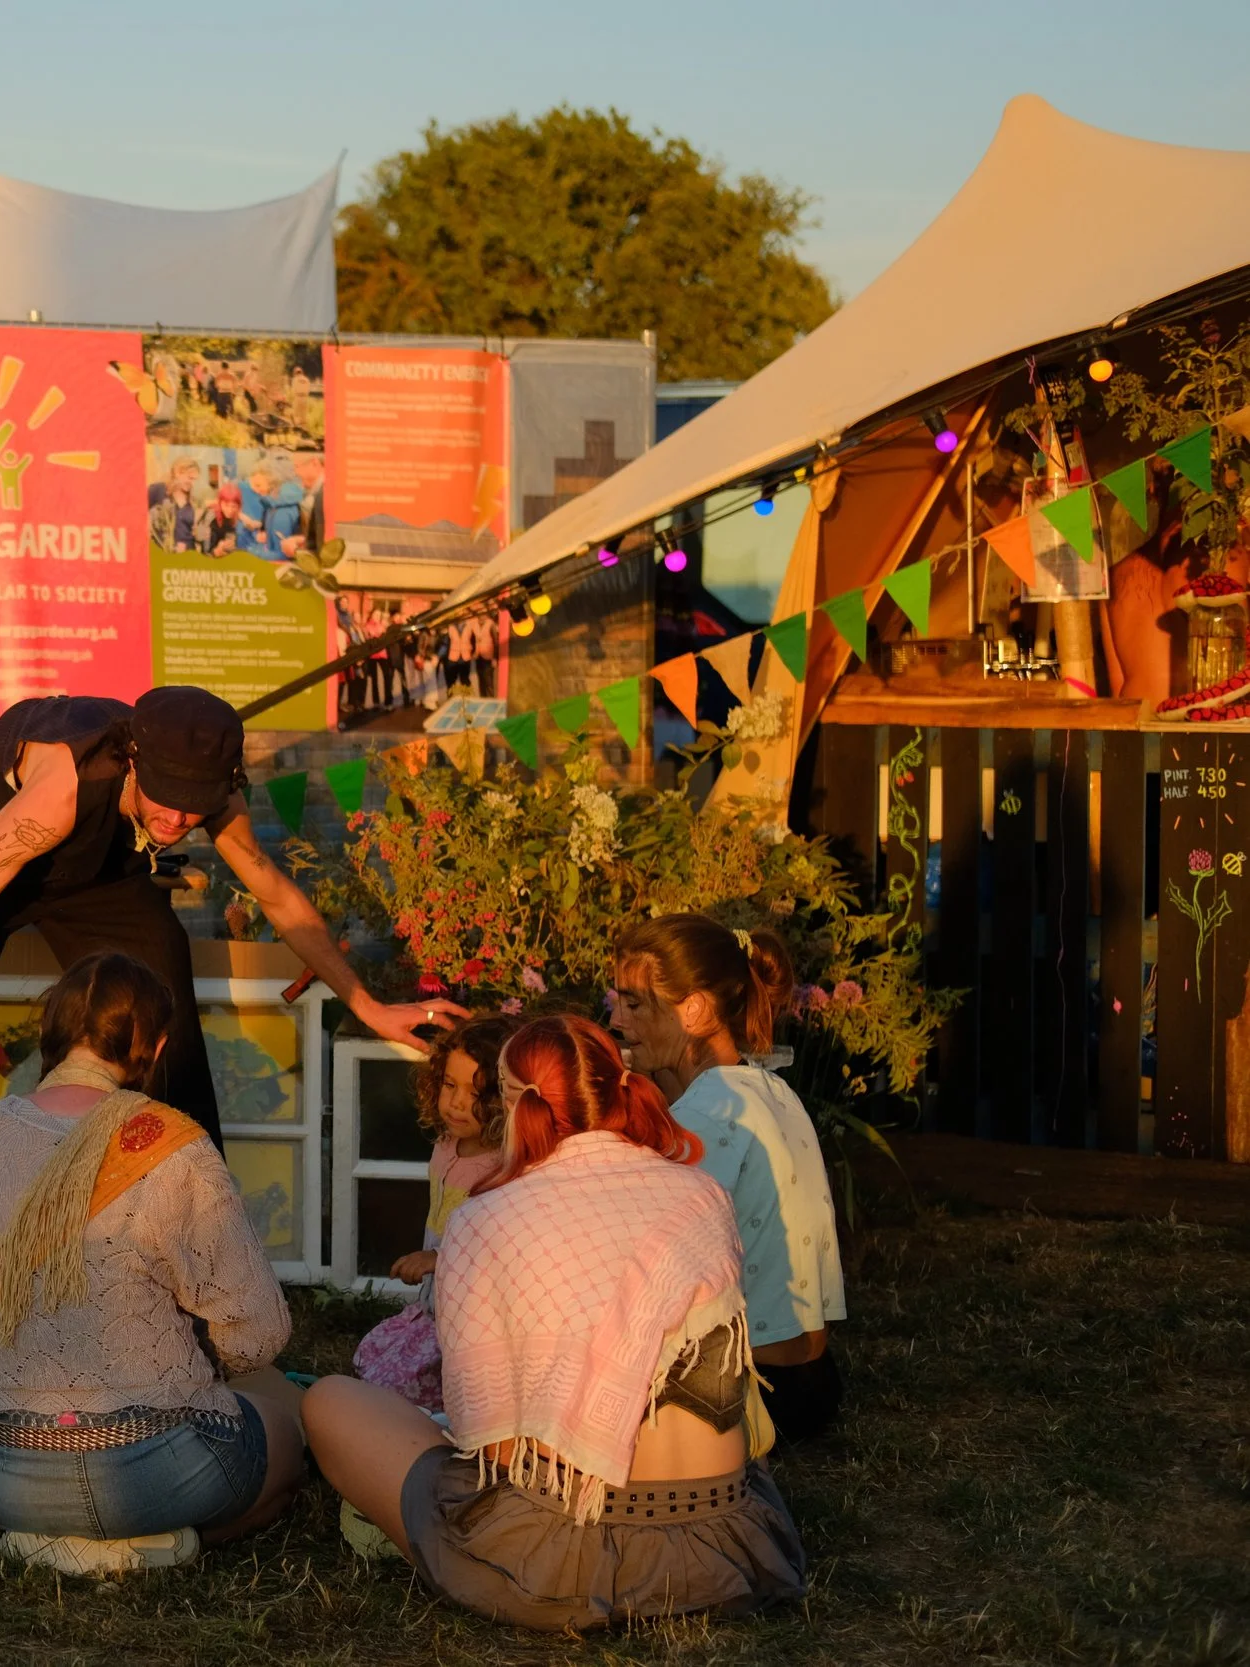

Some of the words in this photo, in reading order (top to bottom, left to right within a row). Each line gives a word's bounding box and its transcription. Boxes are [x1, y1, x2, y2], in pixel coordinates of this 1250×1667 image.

[345, 360, 441, 381] COMMUNITY
[162, 568, 255, 588] COMMUNITY
[30, 585, 51, 602] TO
[56, 586, 126, 604] SOCIETY
[162, 586, 211, 603] GREEN
[213, 587, 268, 606] SPACES
[1196, 767, 1227, 783] 7.30
[1197, 785, 1226, 800] 4.50
